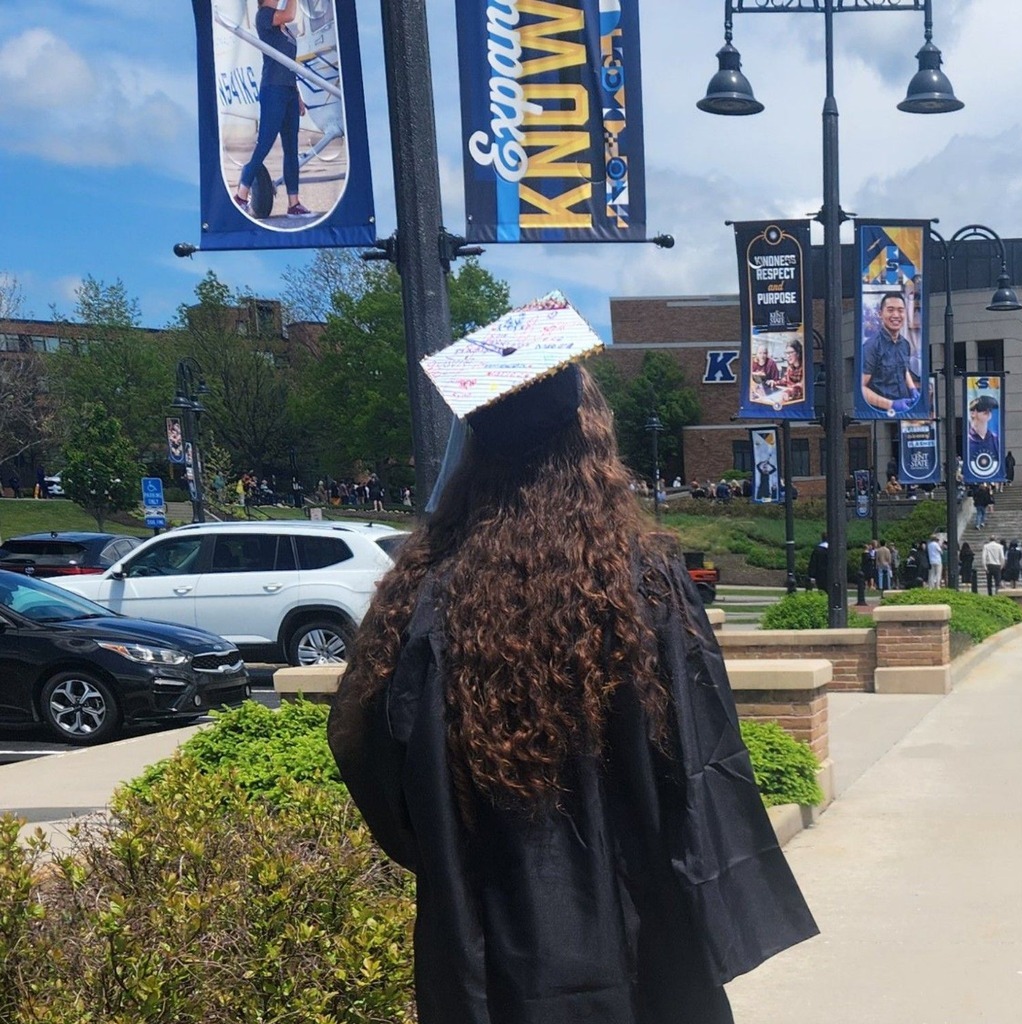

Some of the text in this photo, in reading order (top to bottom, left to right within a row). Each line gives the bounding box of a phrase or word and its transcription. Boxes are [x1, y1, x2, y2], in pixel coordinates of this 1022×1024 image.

[468, 0, 543, 182] Expan
[518, 0, 593, 228] KNOW
[754, 255, 797, 267] KINDNESS
[756, 267, 795, 280] RESPECT
[768, 281, 785, 291] and
[757, 292, 797, 305] PURPOSE
[702, 350, 740, 384] K
